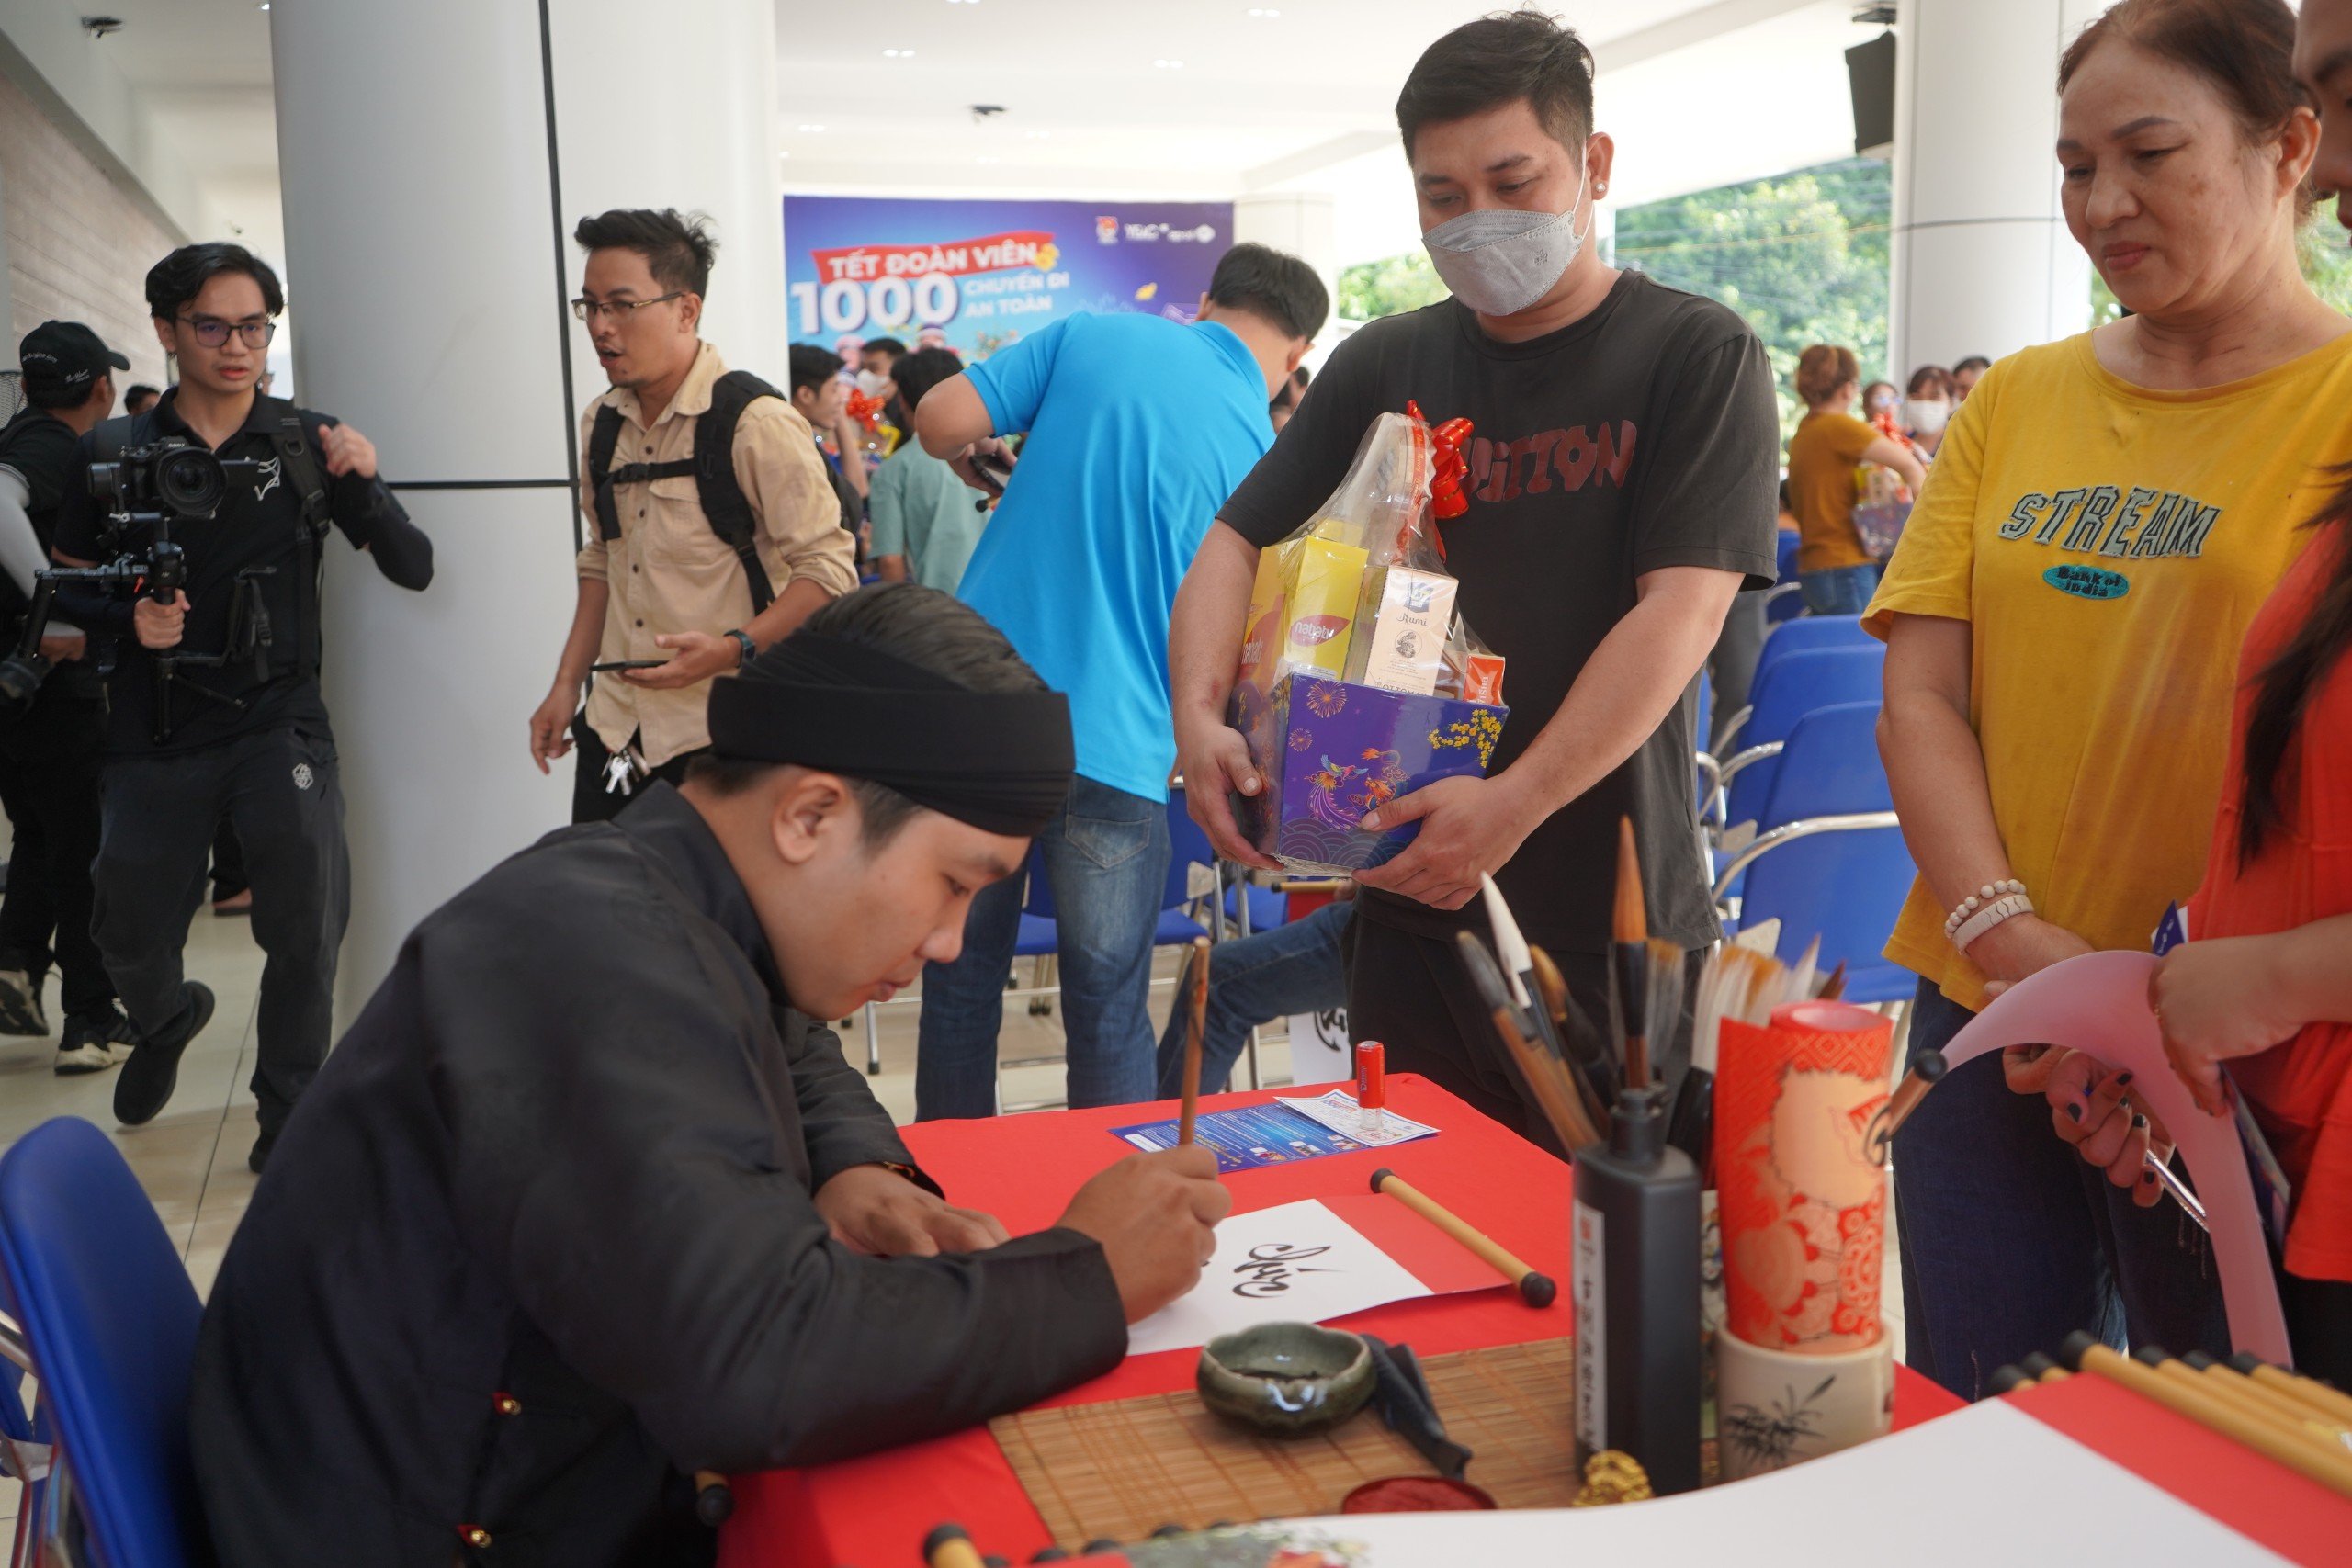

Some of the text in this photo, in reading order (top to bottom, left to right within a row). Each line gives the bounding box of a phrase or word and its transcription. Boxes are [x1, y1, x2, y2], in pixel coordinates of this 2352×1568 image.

[829, 239, 1036, 278] TẾT ĐOÀN VIÊN
[790, 272, 959, 333] 1000
[966, 299, 994, 317] AN
[1997, 485, 2222, 559] STREAM
[2057, 565, 2102, 585] Bank
